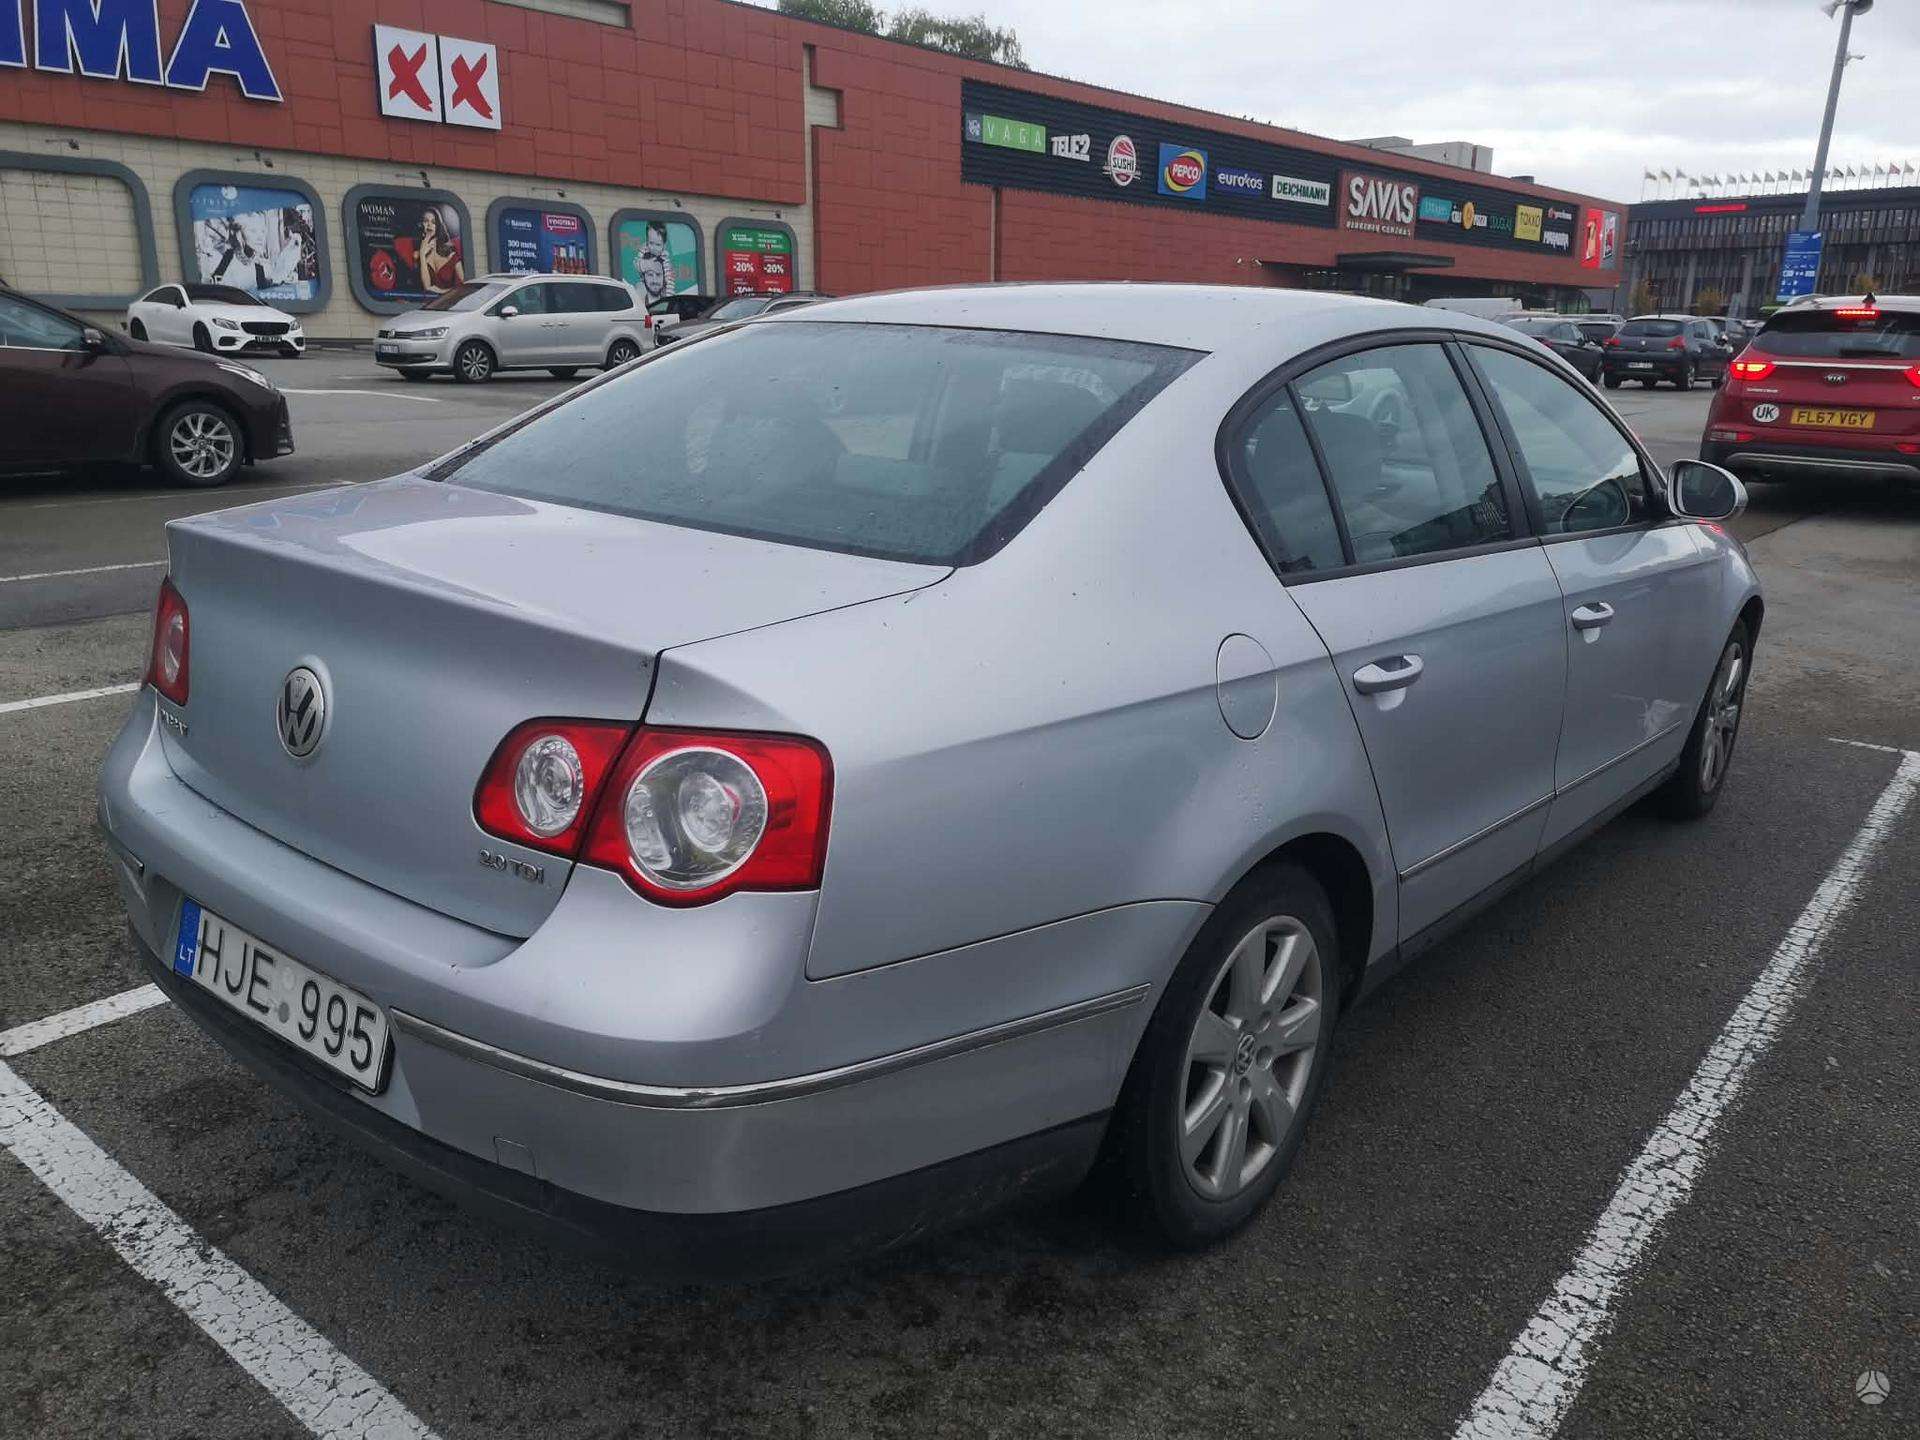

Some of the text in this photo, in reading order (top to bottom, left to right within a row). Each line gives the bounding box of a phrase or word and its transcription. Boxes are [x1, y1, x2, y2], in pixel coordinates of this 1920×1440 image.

[986, 124, 1042, 148] VAGA
[1051, 134, 1091, 162] TELE2
[1112, 157, 1135, 172] SUSHI
[1172, 164, 1199, 180] PEPCO
[1276, 181, 1327, 201] DEICHMANN
[1348, 176, 1415, 224] SAVAS
[360, 203, 395, 216] WOMAN
[733, 262, 755, 273] -20%
[763, 263, 785, 274] -20%
[1756, 407, 1775, 420] UK
[1796, 410, 1868, 426] FL67 VGY
[179, 944, 195, 964] LT
[198, 918, 376, 1072] HJE 995
